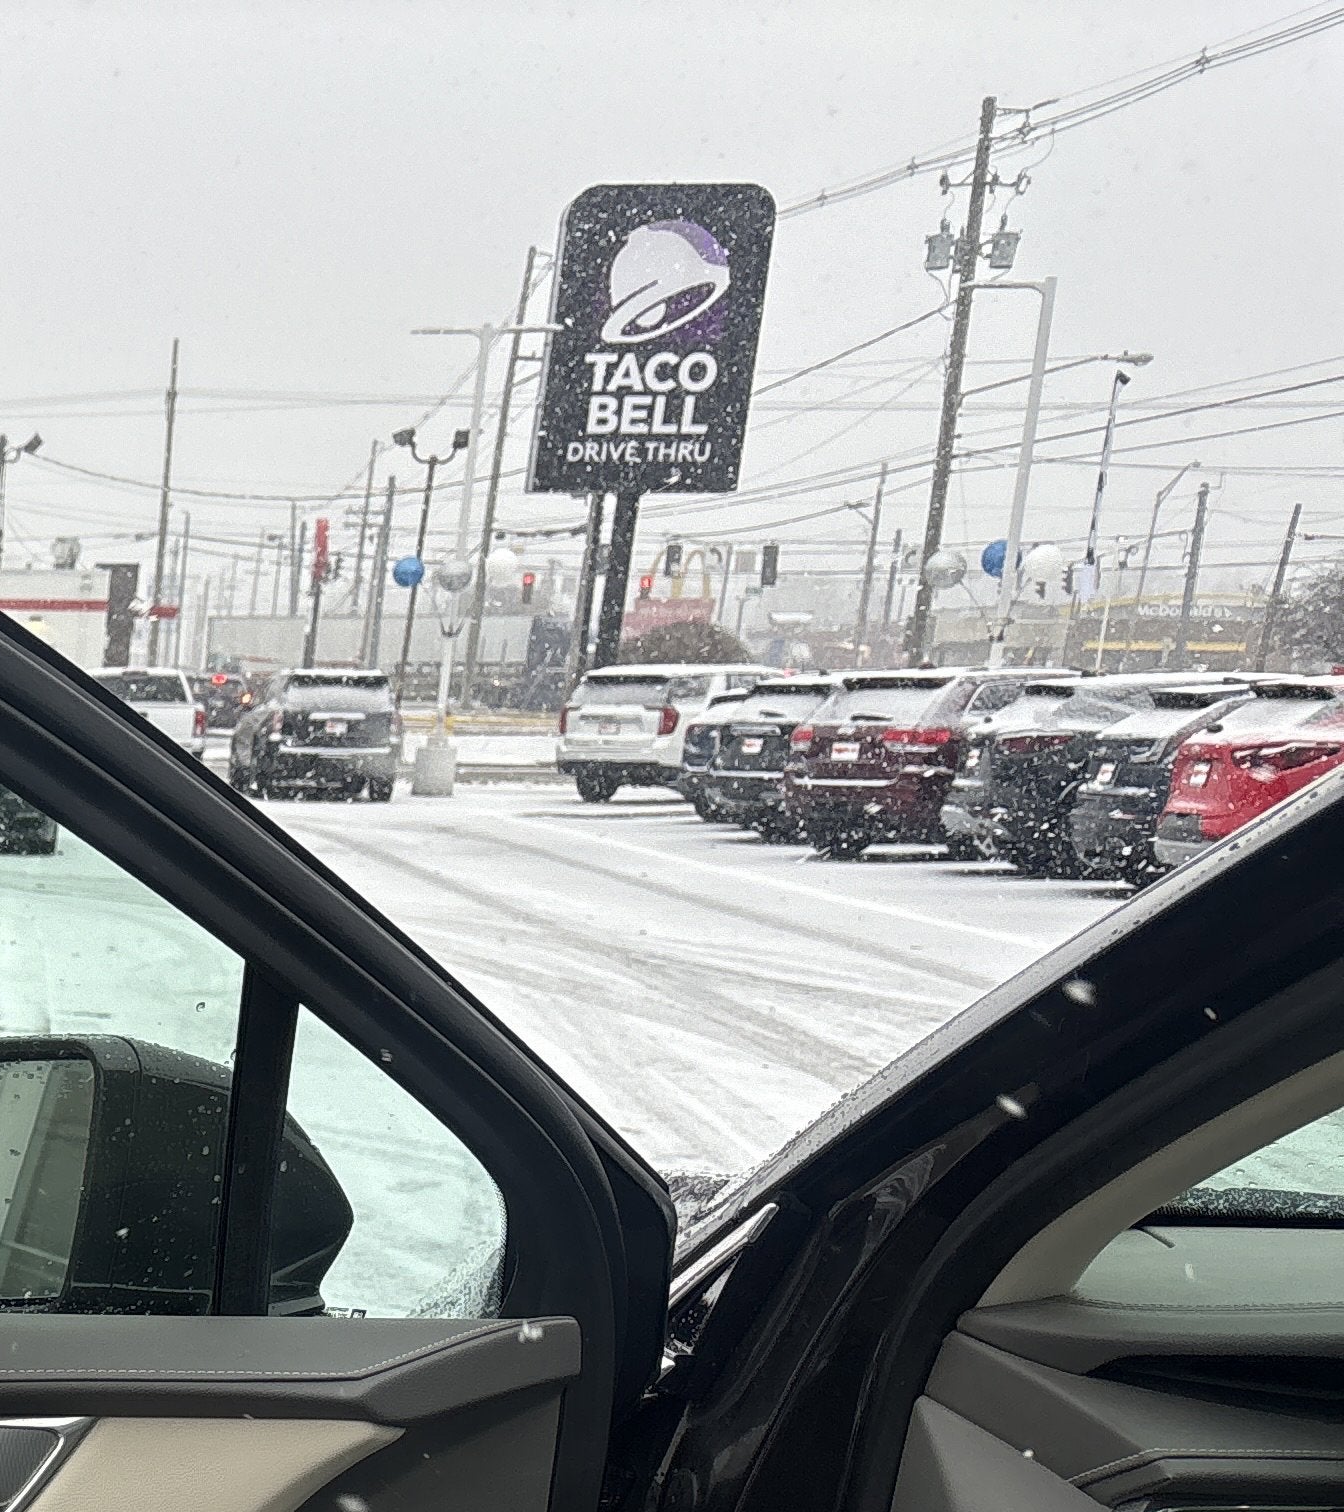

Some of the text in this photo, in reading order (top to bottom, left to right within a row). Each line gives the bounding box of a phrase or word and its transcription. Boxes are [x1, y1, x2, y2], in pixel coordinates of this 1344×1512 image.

[584, 352, 717, 392] TACO
[586, 394, 708, 434] BELL
[566, 441, 711, 463] DRIVE THRU
